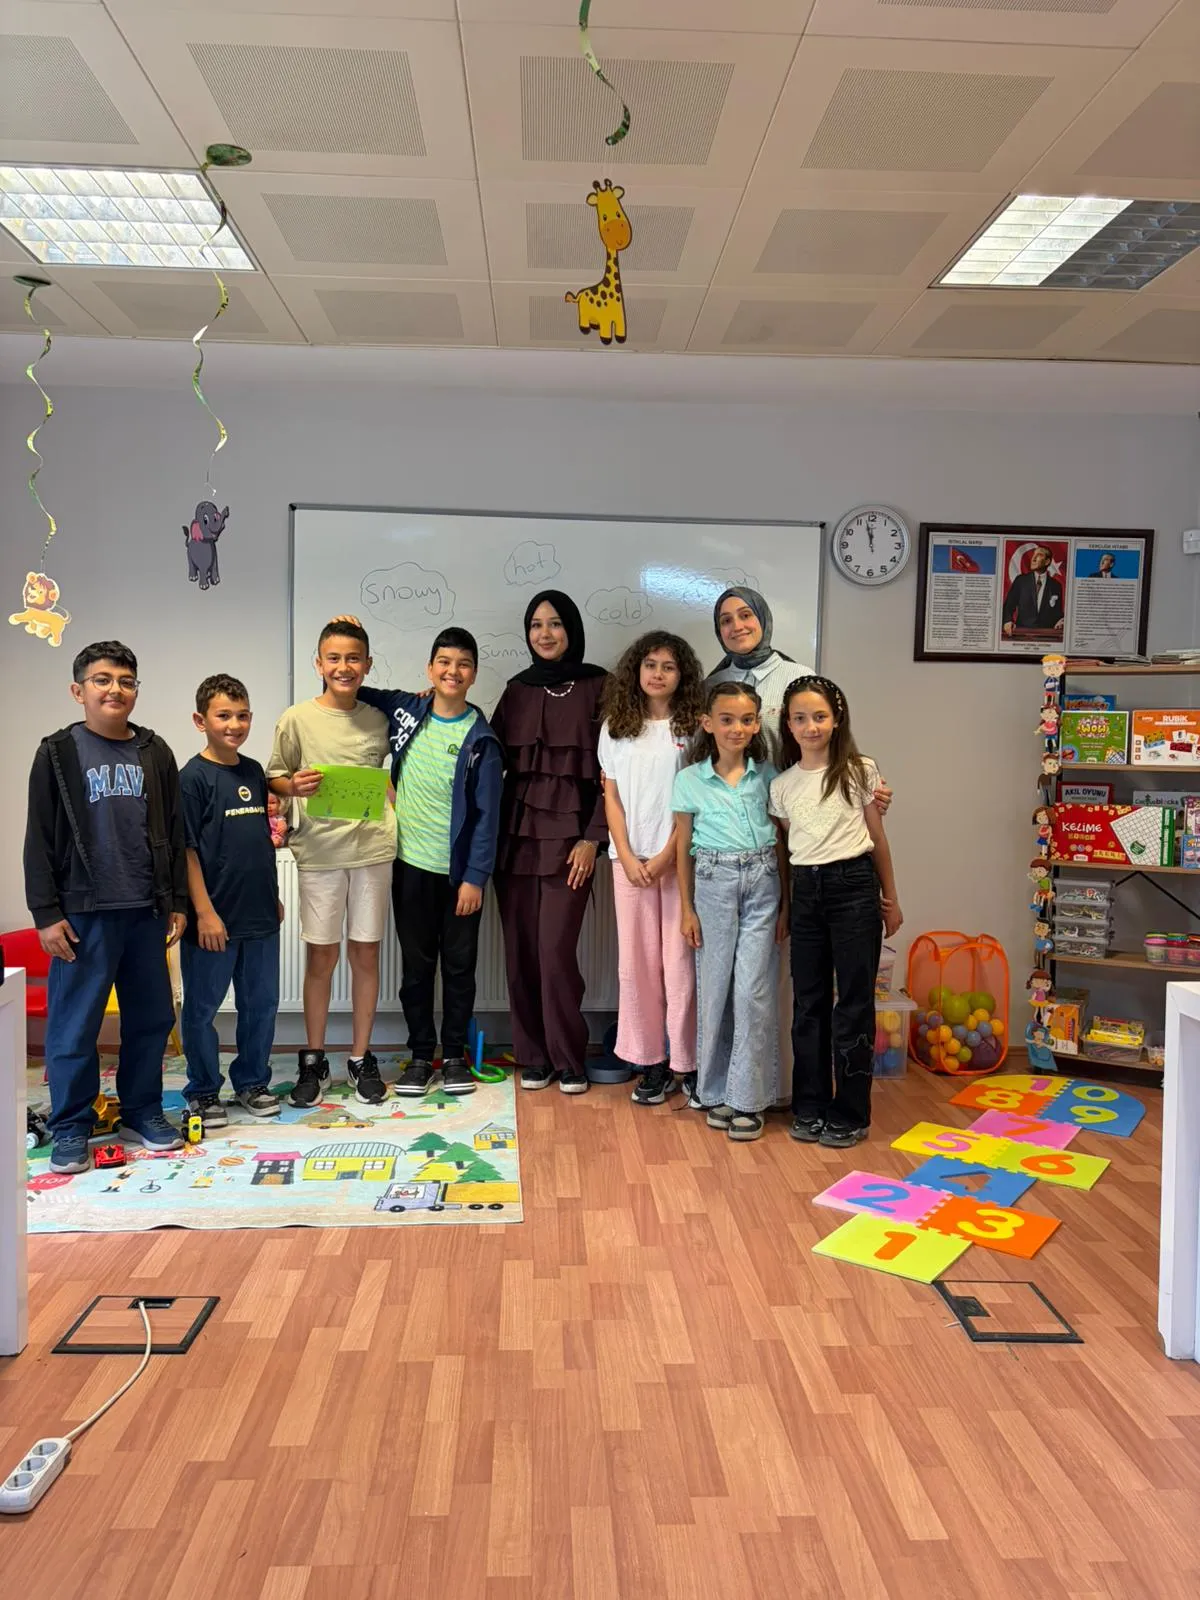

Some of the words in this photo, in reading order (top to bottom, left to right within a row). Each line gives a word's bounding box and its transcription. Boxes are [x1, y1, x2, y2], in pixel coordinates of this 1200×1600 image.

[856, 518, 862, 526] 11
[868, 514, 877, 522] 12
[846, 528, 854, 536] 10
[890, 529, 898, 537] 2
[841, 541, 849, 549] 9
[894, 542, 902, 550] 3
[513, 552, 548, 576] hot
[844, 554, 853, 563] 8
[854, 565, 861, 573] 7
[866, 569, 874, 577] 6
[880, 565, 888, 573] 5
[598, 598, 641, 622] cold
[87, 764, 148, 803] MAV
[975, 1089, 1024, 1109] 8
[1069, 1105, 1119, 1124] 9
[999, 1117, 1050, 1137] 7
[922, 1131, 981, 1152] 5
[1020, 1154, 1076, 1175] 6
[845, 1183, 910, 1214] 2
[957, 1208, 1025, 1239] 3
[873, 1230, 917, 1261] 1
